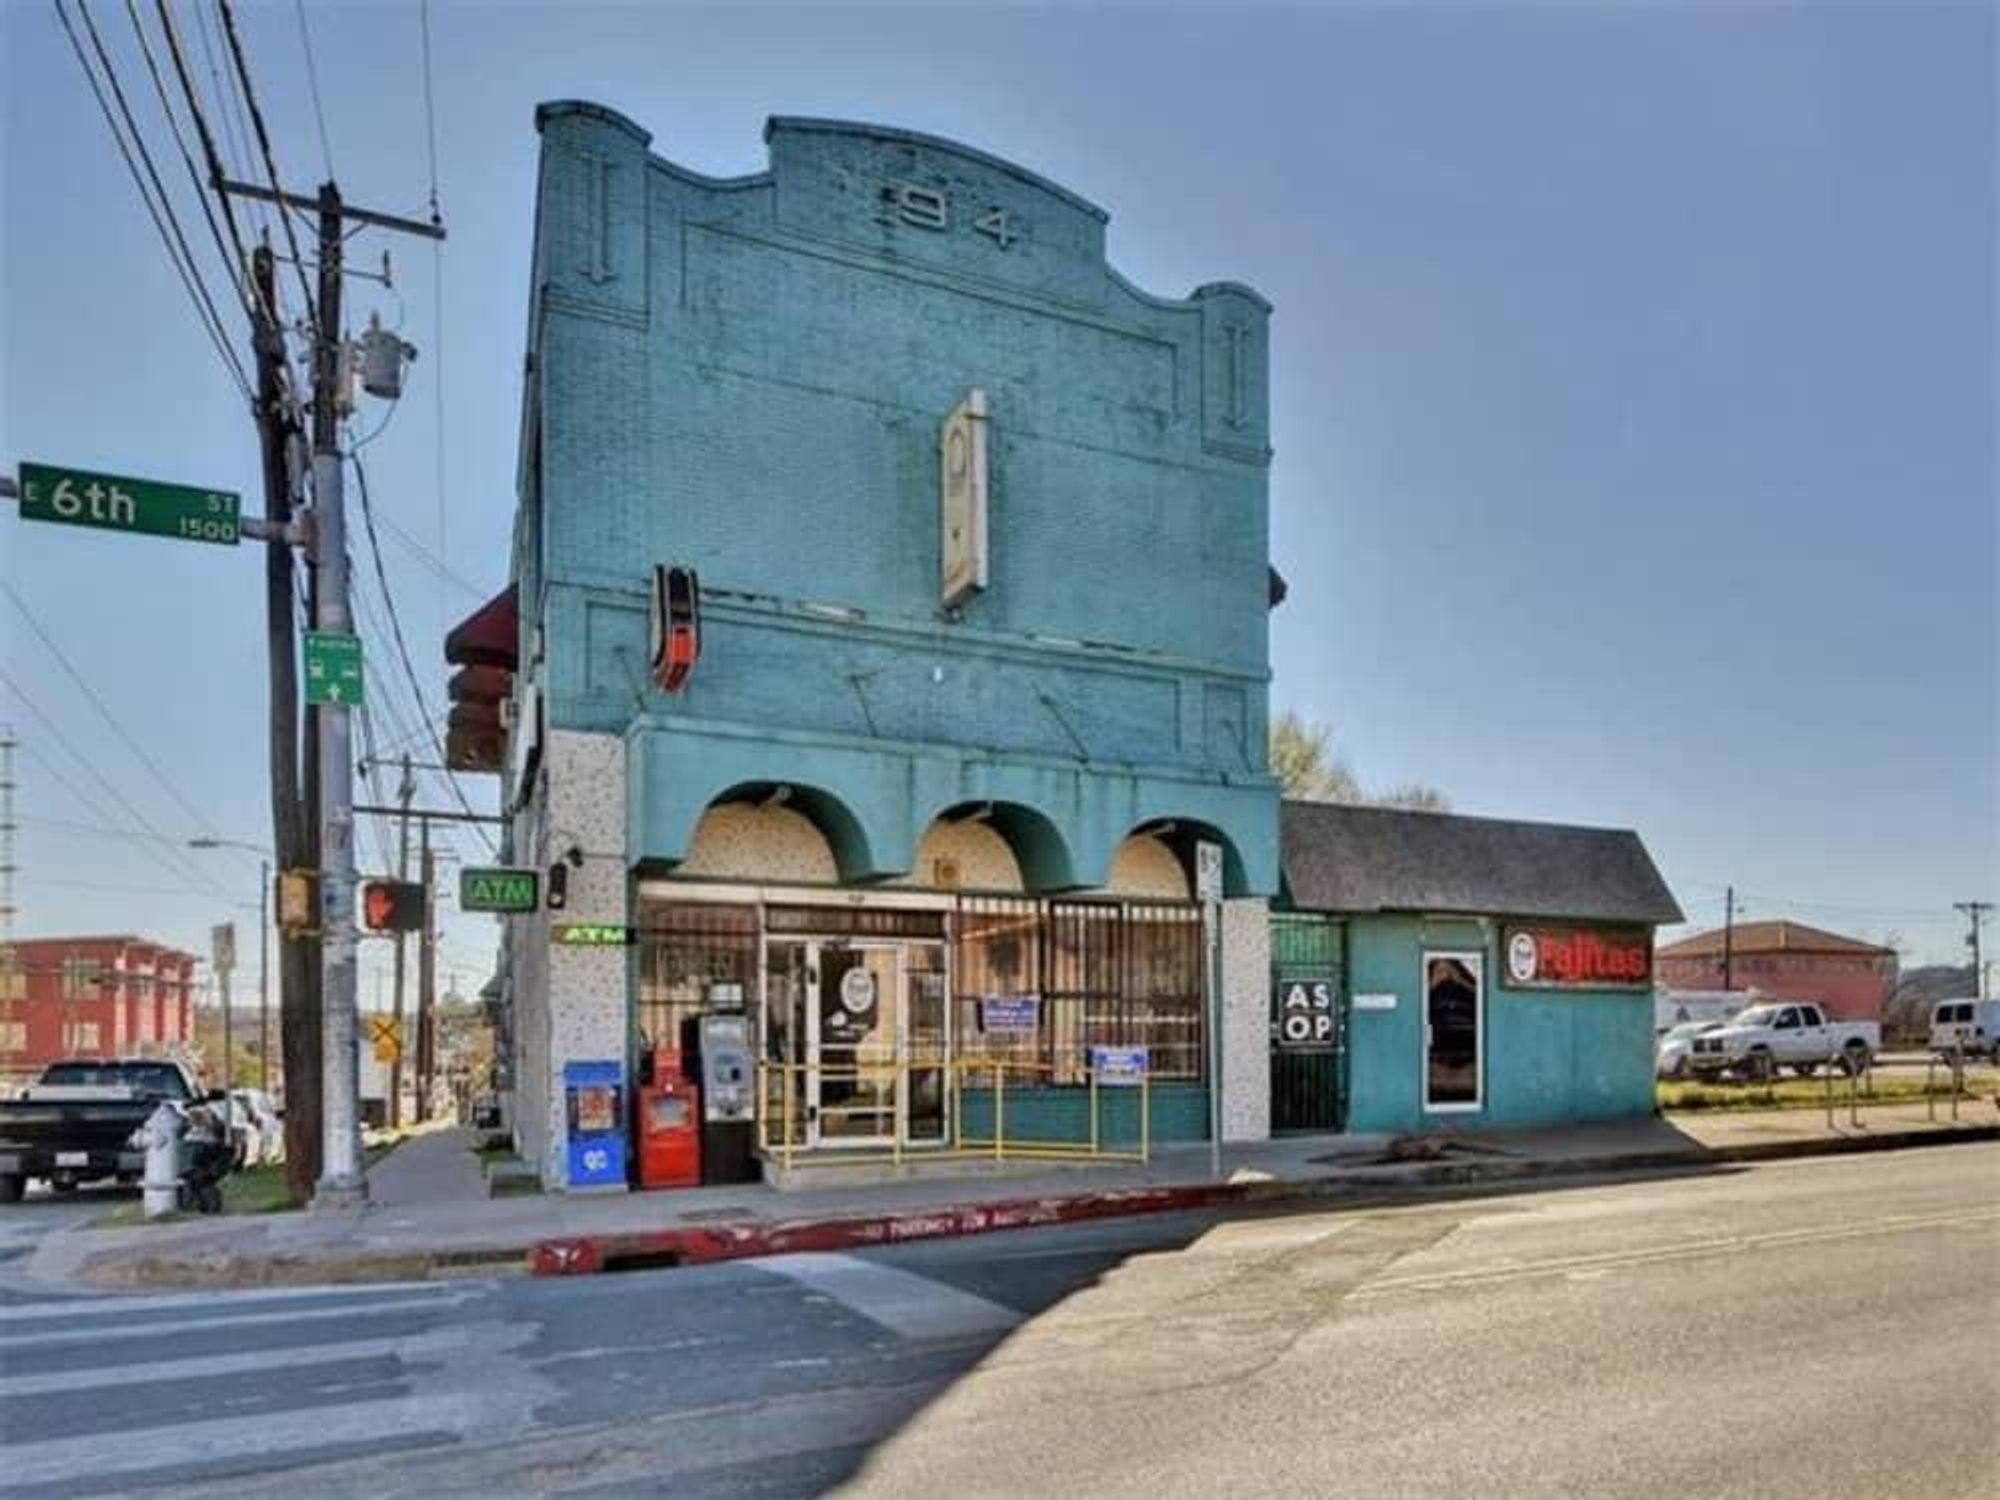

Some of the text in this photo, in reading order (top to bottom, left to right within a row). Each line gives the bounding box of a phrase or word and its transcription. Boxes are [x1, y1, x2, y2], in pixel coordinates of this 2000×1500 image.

[24, 478, 233, 524] E 6th ST
[179, 516, 235, 541] 1500
[473, 878, 530, 902] ATM
[565, 926, 625, 943] ATM
[1285, 983, 1330, 1009] AS
[1285, 1015, 1330, 1040] OP
